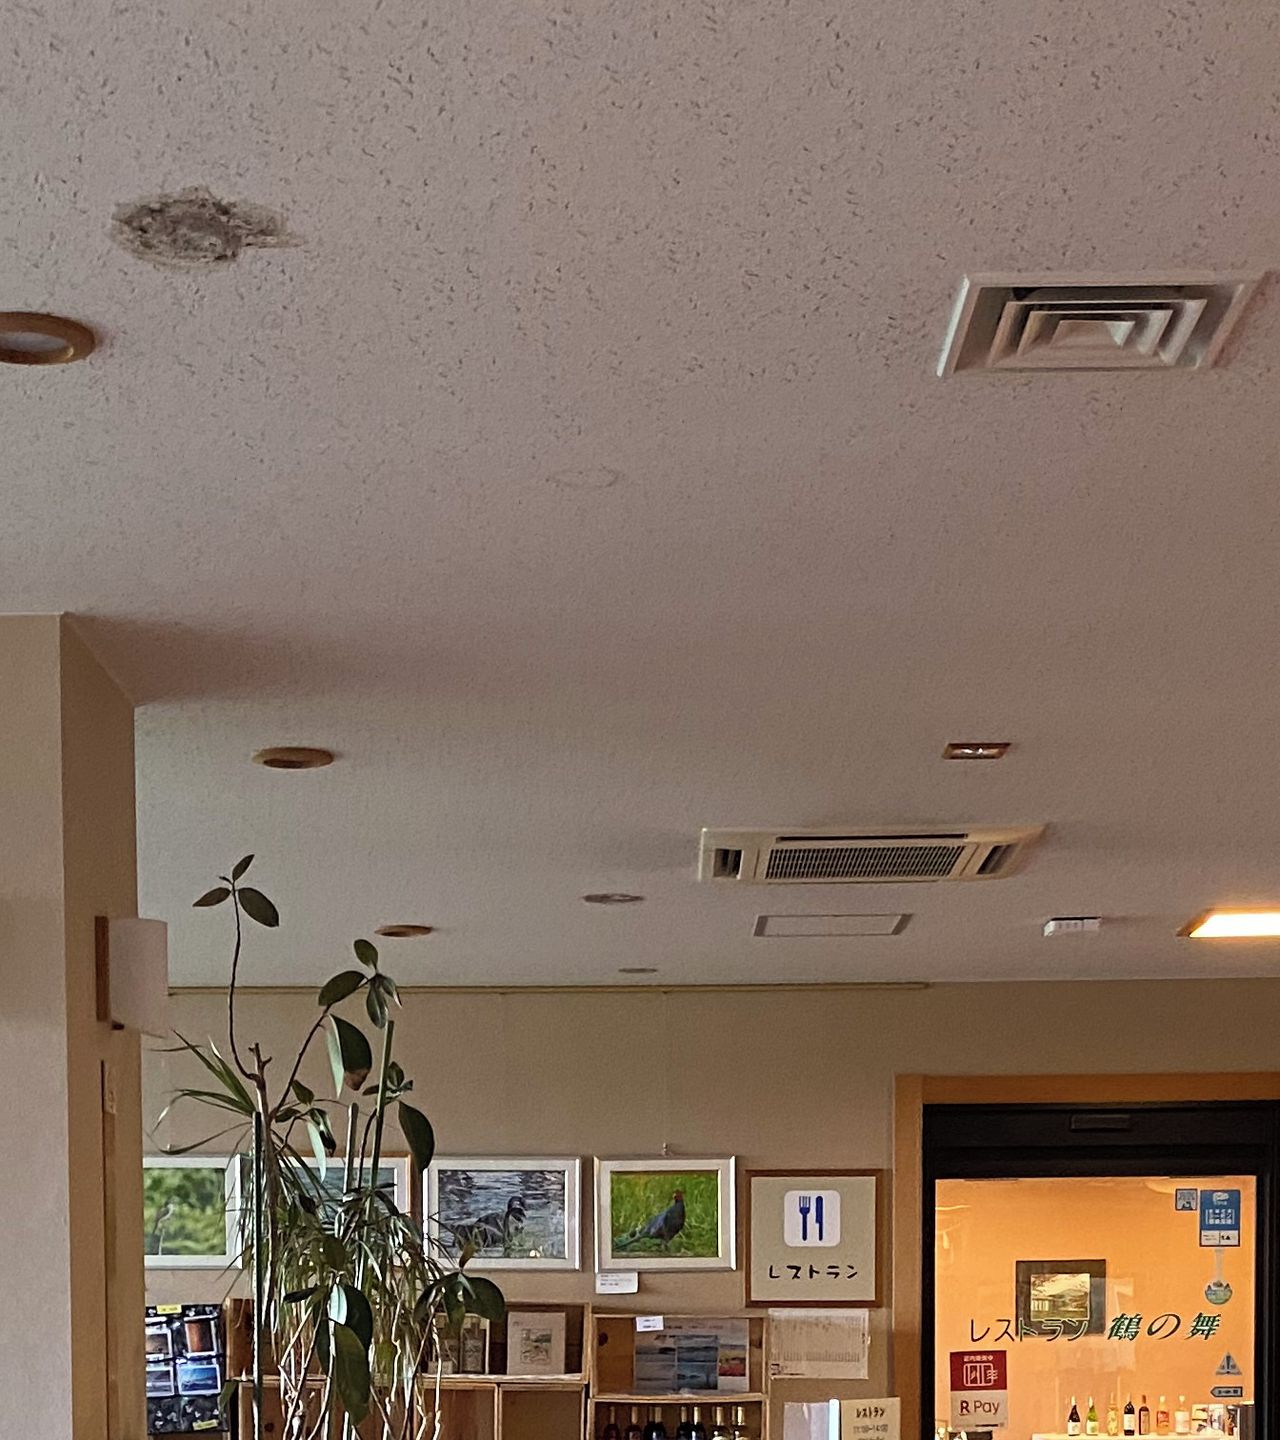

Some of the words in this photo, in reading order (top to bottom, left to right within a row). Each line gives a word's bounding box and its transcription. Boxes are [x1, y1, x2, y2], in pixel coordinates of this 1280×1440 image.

[769, 1265, 858, 1280] レストラン
[970, 1319, 1088, 1342] レストラン
[1107, 1312, 1220, 1341] 鶴の舞
[856, 1407, 885, 1418] レストラン
[973, 1400, 1000, 1415] Pay
